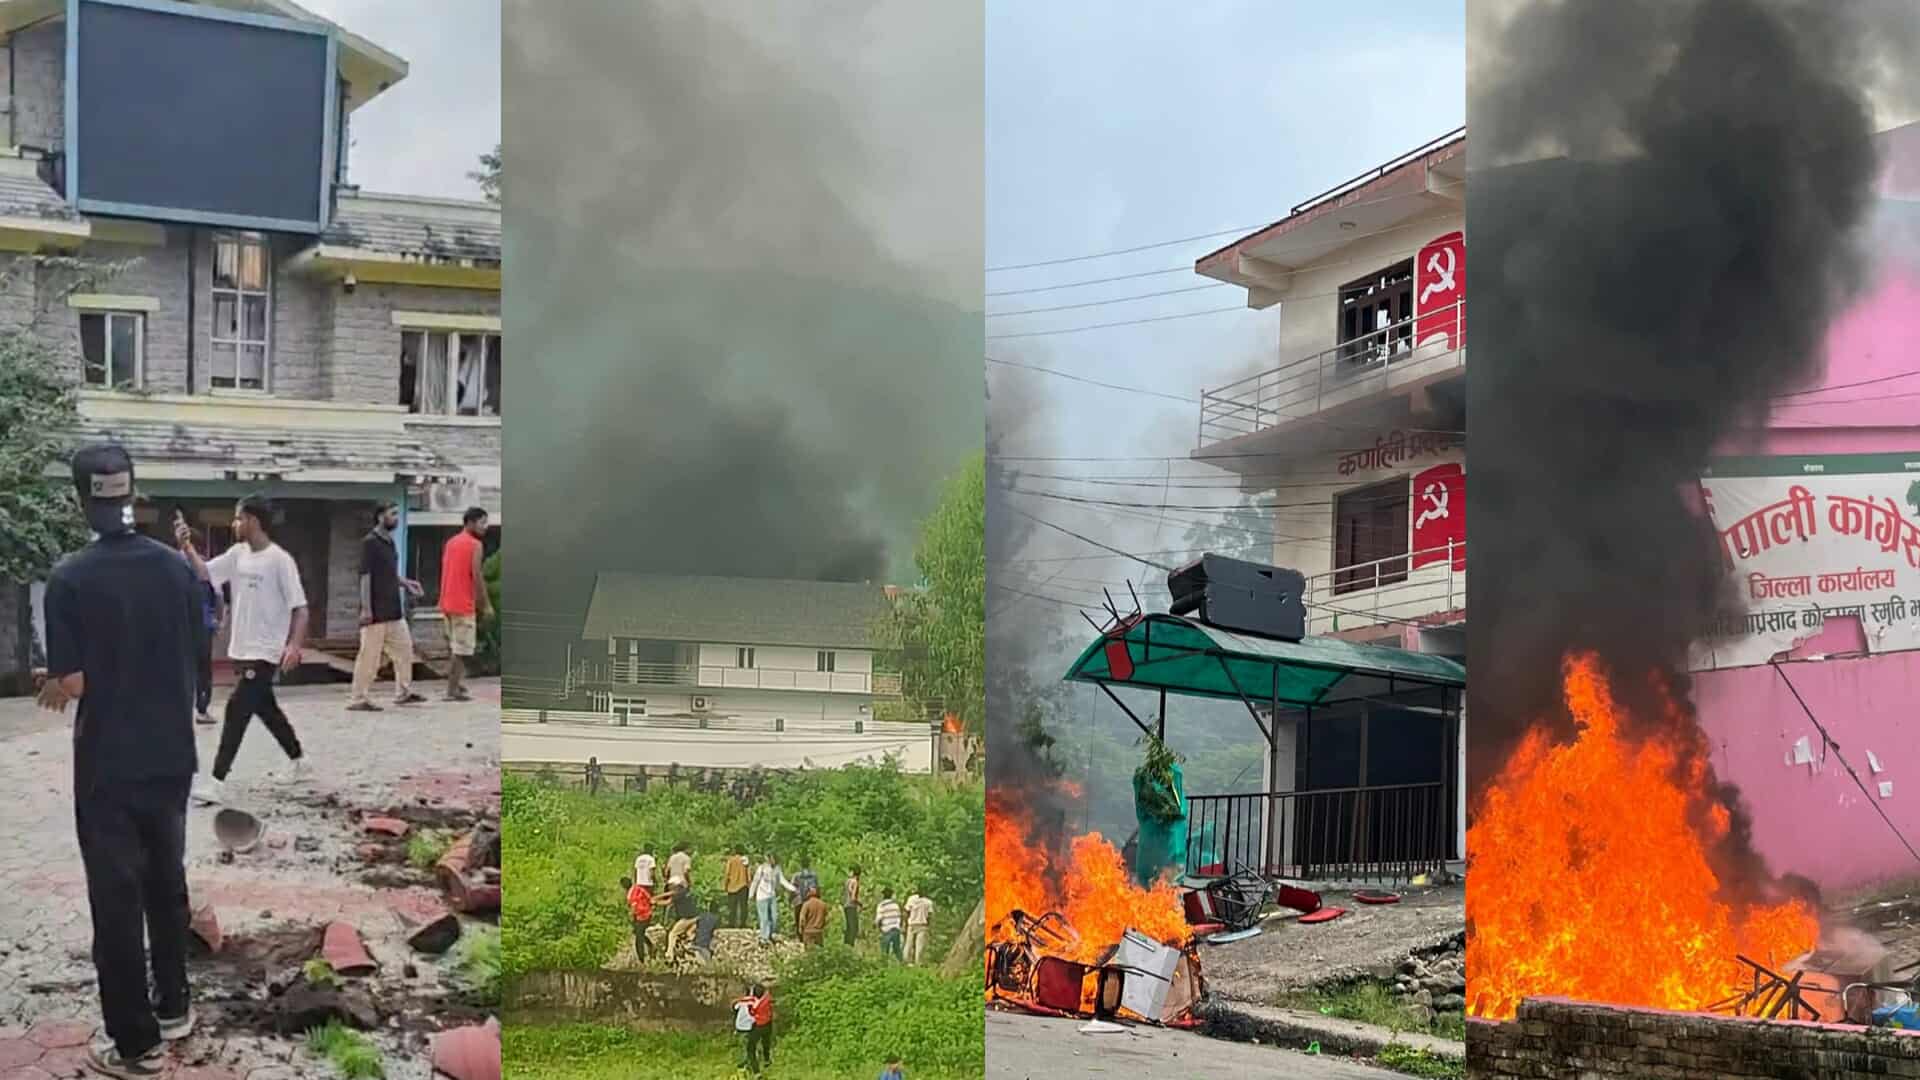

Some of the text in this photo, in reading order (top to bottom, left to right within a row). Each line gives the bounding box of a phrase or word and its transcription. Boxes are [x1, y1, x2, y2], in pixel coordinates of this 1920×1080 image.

[1749, 566, 1895, 599] जिल्ला कार्यालय
[1870, 595, 1906, 627] स्मृति
